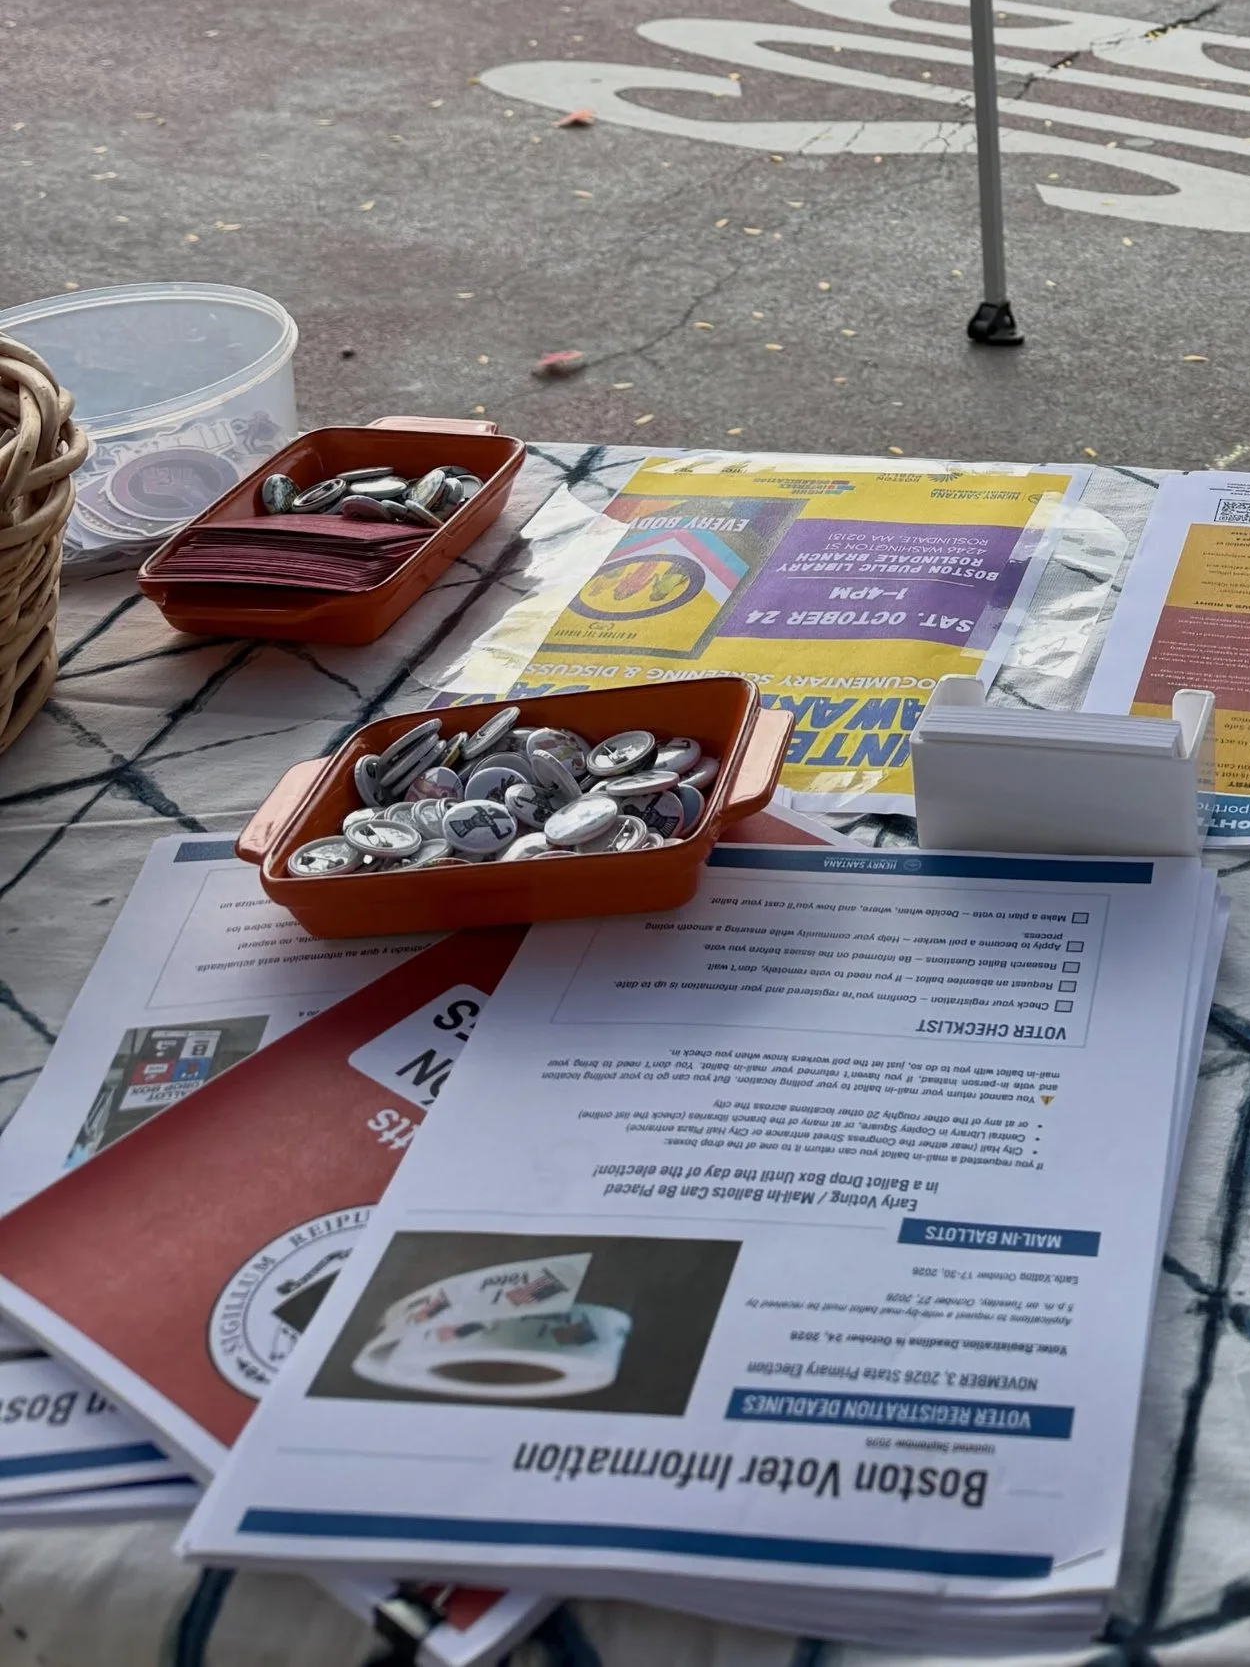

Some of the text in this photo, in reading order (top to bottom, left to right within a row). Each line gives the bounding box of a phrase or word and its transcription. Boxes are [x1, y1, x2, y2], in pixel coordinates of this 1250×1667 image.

[930, 490, 1019, 502] HENRY SANTANA
[627, 516, 750, 533] EVERY BODY
[828, 532, 989, 546] ROSLINDALE, MA 02131
[823, 542, 987, 555] 4246 WASHINGTON ST
[796, 552, 983, 567] ROSLINDALE BRANCH
[776, 561, 1000, 582] BOSTON PUBLIC LIBRARY
[745, 609, 974, 633] SAT. OCTOBER 24
[623, 666, 642, 679] &
[823, 857, 897, 870] HENRY SANTANA
[915, 1018, 1067, 1041] VOTER CHECKLIST
[592, 1164, 939, 1194] in a Ballot Drop Box Until the day of the election!
[603, 1182, 654, 1197] Placed
[658, 1183, 678, 1199] Be
[680, 1184, 709, 1199] Can
[712, 1185, 764, 1202] Ballots
[766, 1188, 816, 1205] Mail-In
[829, 1191, 877, 1209] Voting
[882, 1194, 918, 1212] Early
[925, 1225, 1062, 1249] MAIL-IN BALLOTS
[219, 1254, 276, 1357] SIGILLUM
[747, 1361, 1038, 1392] NOVEMBER 3, 2026 State Primary Election
[742, 1393, 1031, 1431] VOTER REGISTRATION DEADLINES
[512, 1441, 989, 1509] Boston Voter Information
